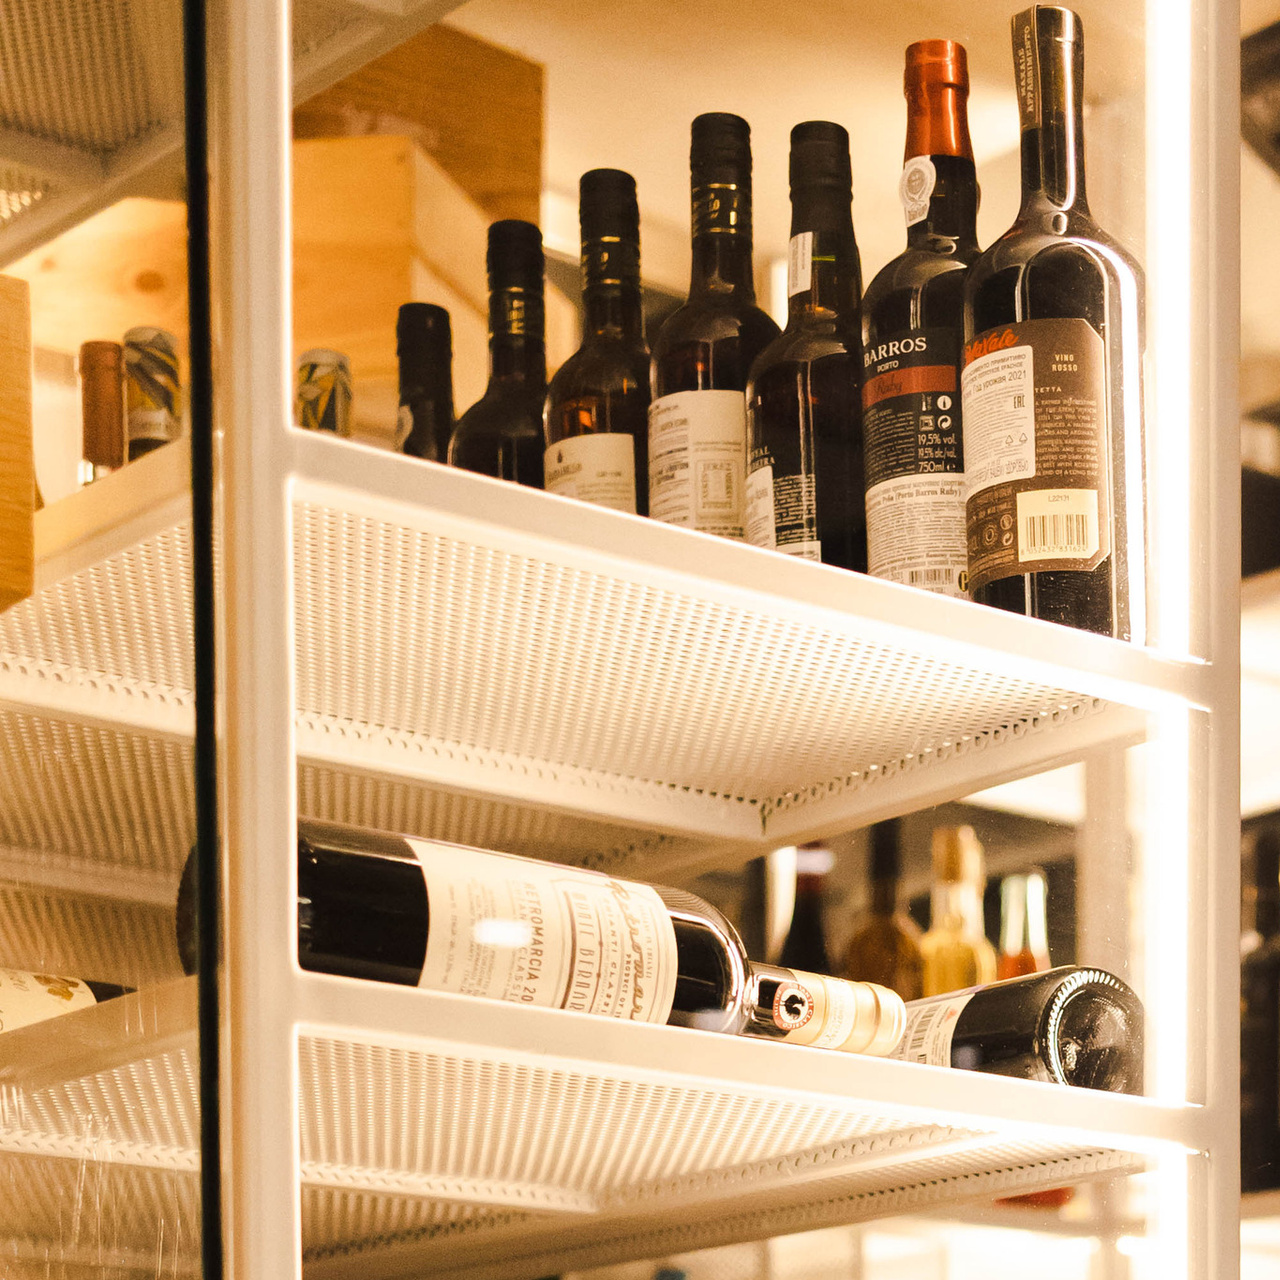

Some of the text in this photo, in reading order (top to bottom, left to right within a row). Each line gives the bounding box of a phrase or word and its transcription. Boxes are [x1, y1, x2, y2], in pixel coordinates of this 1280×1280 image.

[1018, 48, 1026, 97] MAXALE
[863, 337, 927, 368] BARROS
[1054, 354, 1075, 362] VINO
[877, 360, 899, 373] PORTO
[1051, 364, 1078, 372] ROSSO
[1008, 370, 1027, 382] 2021
[919, 461, 945, 473] 750ml
[525, 883, 545, 982] RETROMARCIA
[507, 947, 528, 1003] CLASSI
